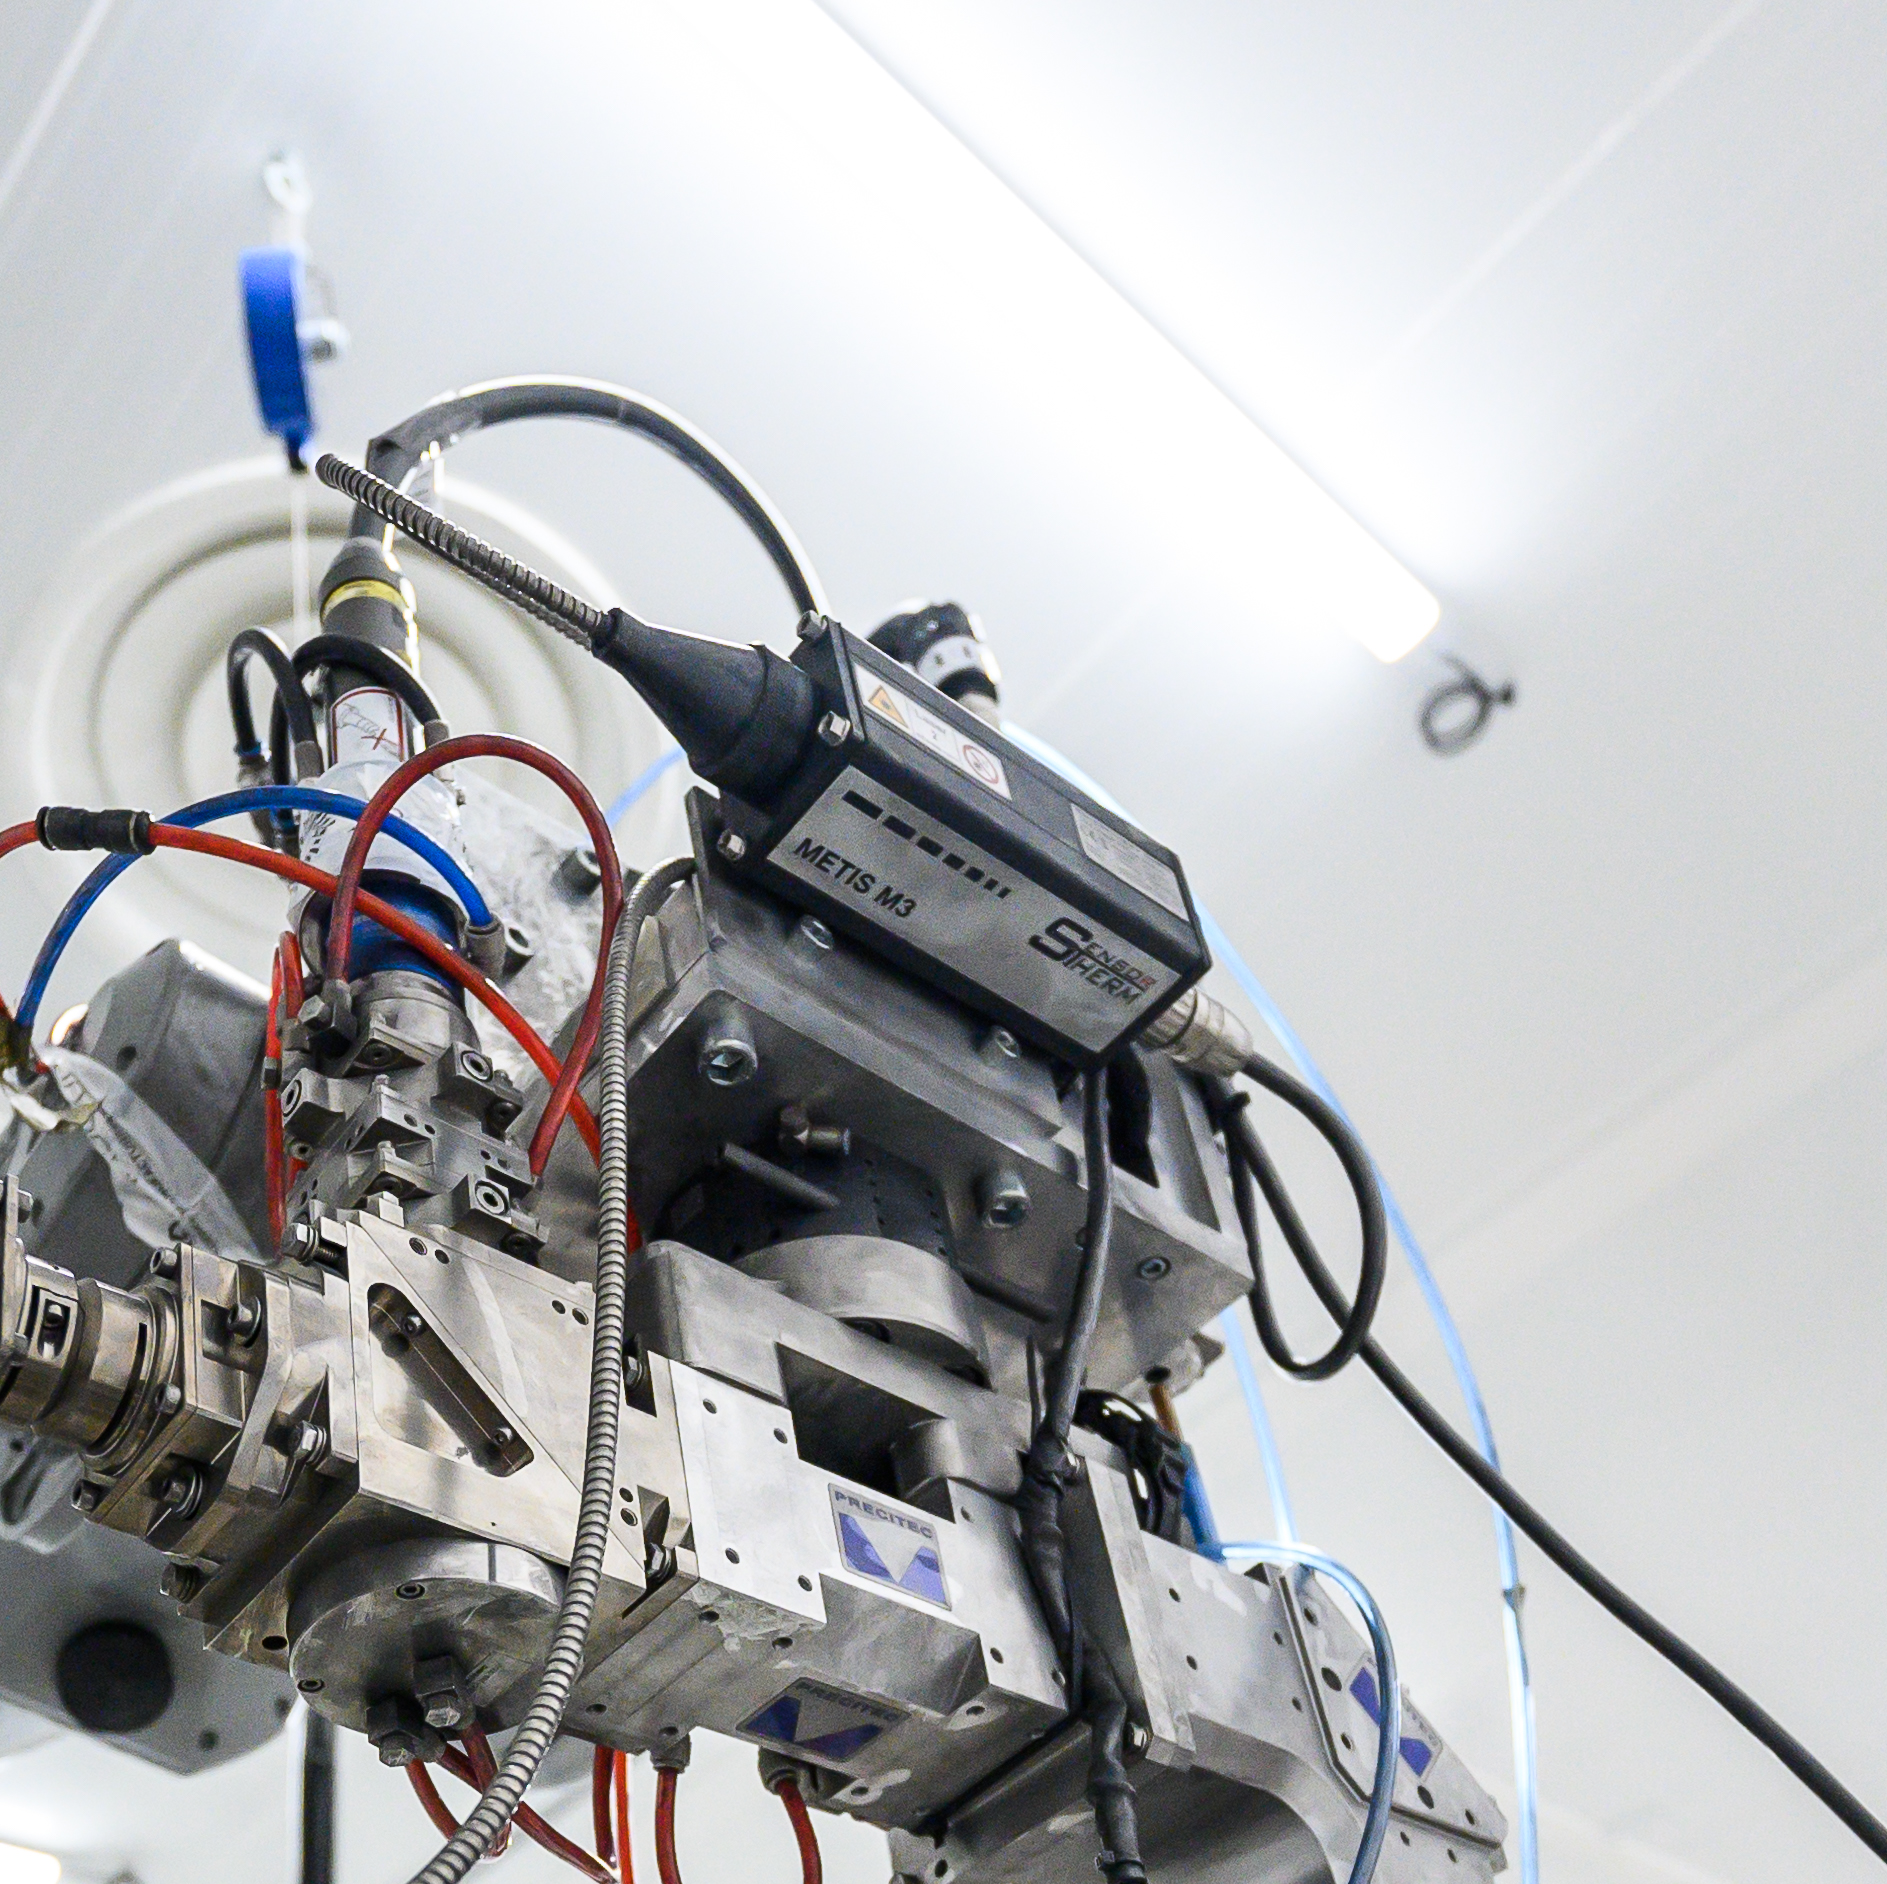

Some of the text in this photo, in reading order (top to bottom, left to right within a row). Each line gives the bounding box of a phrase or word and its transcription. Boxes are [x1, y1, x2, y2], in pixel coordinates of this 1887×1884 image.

[793, 837, 917, 918] METIS M3
[834, 1489, 933, 1539] PRECITEC
